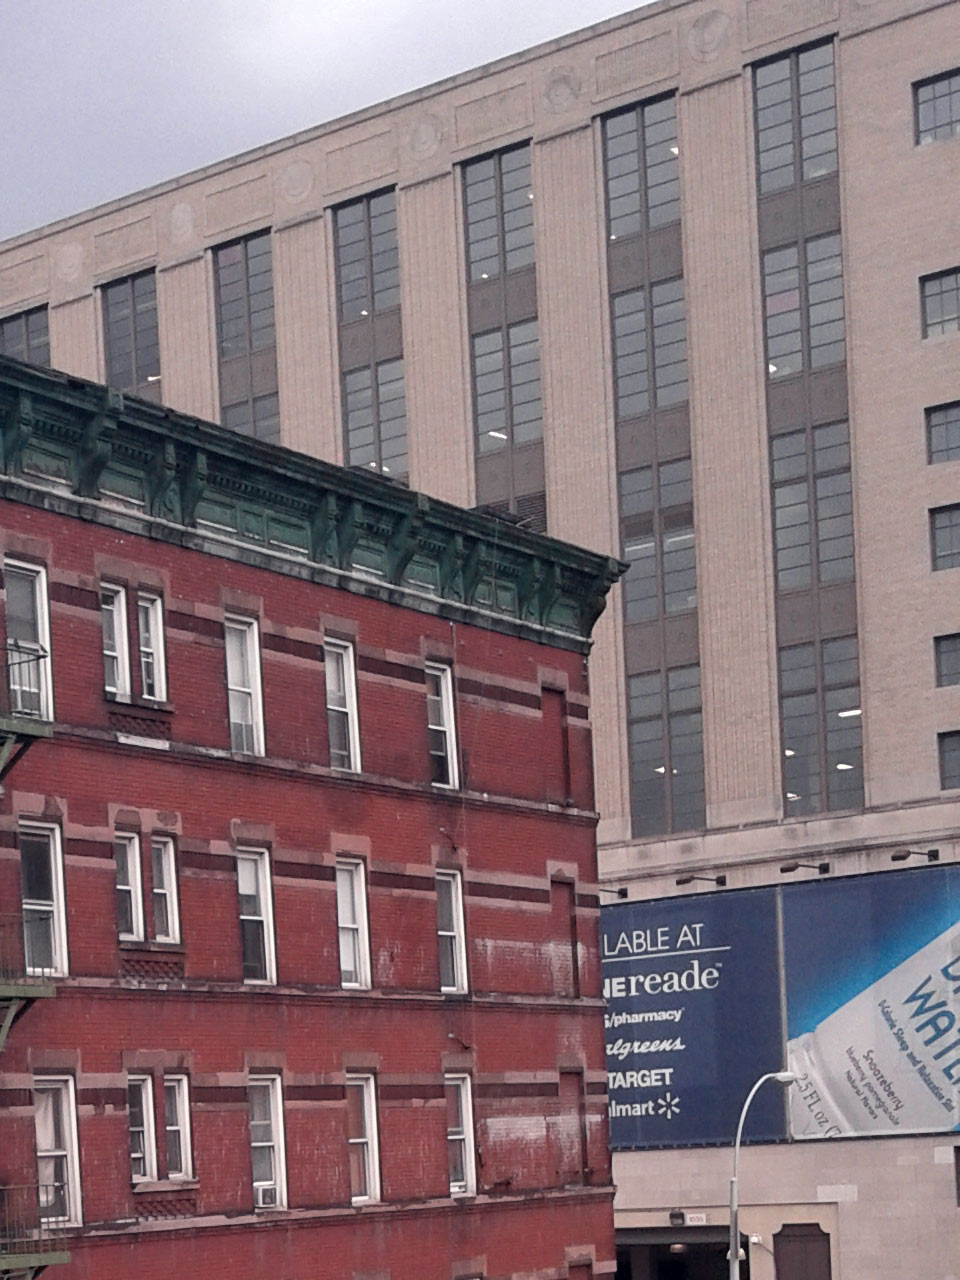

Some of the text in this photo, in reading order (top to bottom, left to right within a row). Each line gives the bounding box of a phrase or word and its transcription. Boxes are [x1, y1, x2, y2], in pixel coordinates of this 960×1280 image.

[603, 923, 704, 956] LABLE AT
[607, 1068, 674, 1089] TARGET
